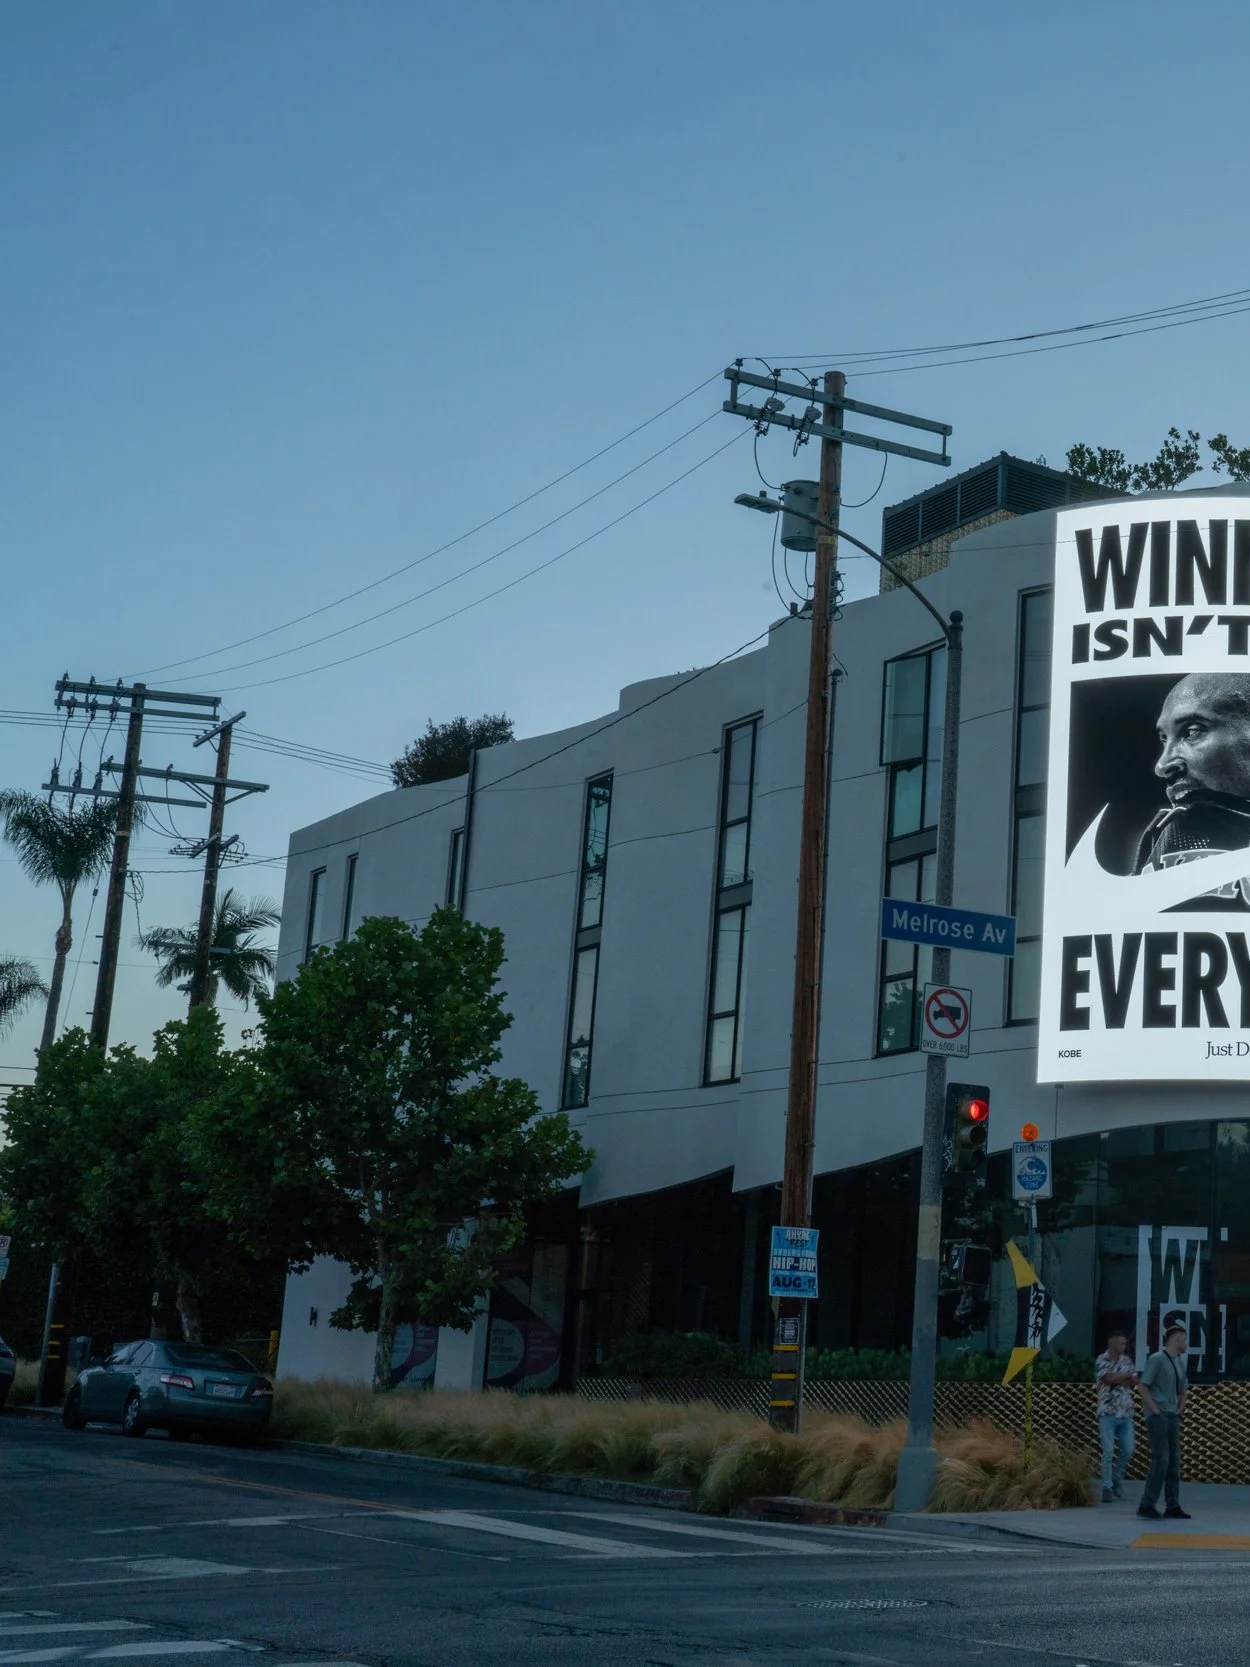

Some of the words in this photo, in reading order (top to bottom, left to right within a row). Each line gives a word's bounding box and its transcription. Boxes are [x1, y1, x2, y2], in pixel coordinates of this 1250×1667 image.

[892, 908, 975, 940] Melrose
[982, 921, 1007, 944] Av
[922, 1039, 937, 1049] OVER
[1205, 1041, 1233, 1059] Just
[1058, 1050, 1082, 1058] KOBE
[1015, 1144, 1048, 1153] ENTERING
[773, 1257, 816, 1271] HIP-HOP
